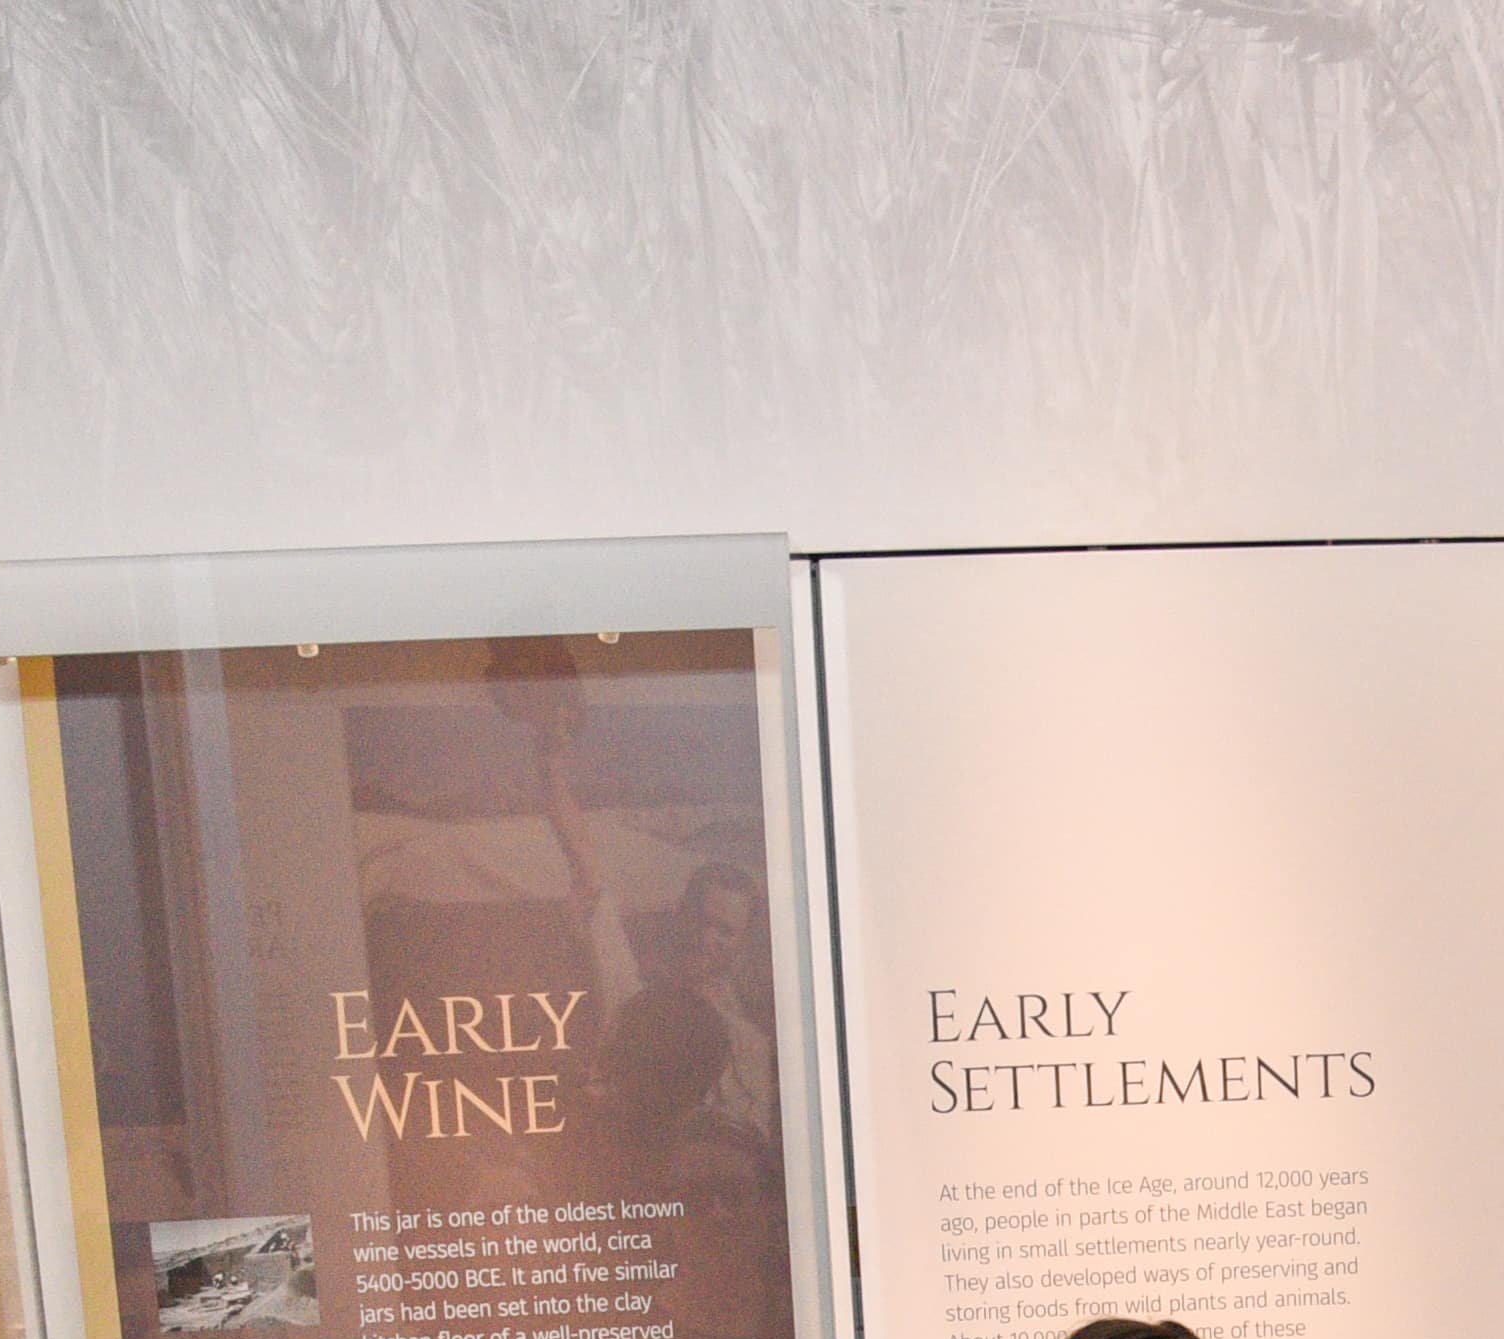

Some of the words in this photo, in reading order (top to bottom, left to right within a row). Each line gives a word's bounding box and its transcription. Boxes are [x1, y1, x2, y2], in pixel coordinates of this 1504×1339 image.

[330, 990, 587, 1061] EARLY
[927, 989, 1132, 1043] EARLY
[930, 1050, 1376, 1114] SETTLEMENTS
[332, 1072, 566, 1141] WINE
[939, 1184, 958, 1201] At
[965, 1182, 995, 1200] the
[1002, 1179, 1036, 1198] end
[1045, 1178, 1062, 1196] of
[1069, 1177, 1099, 1196] the
[1107, 1177, 1132, 1194] Ice
[1139, 1176, 1176, 1197] Age,
[1183, 1171, 1248, 1191] around
[1256, 1169, 1312, 1189] 12,000
[1319, 1170, 1368, 1189] years
[350, 1211, 390, 1231] This
[396, 1210, 420, 1233] jar
[427, 1208, 442, 1227] is
[448, 1211, 484, 1226] one
[491, 1204, 510, 1225] of
[516, 1204, 548, 1223] the
[555, 1202, 614, 1221] oldest
[621, 1199, 683, 1218] known
[941, 1242, 989, 1264] living
[996, 1241, 1011, 1259] in
[1019, 1238, 1067, 1258] small
[1075, 1236, 1186, 1255] settlements
[1194, 1232, 1249, 1252] nearly
[1256, 1227, 1359, 1252] year-round.
[356, 1270, 458, 1292] 5400-5000
[465, 1268, 504, 1287] BCE.
[512, 1267, 525, 1284] It
[531, 1264, 566, 1284] and
[573, 1262, 608, 1282] five
[615, 1259, 677, 1280] similar
[944, 1273, 988, 1294] They
[995, 1271, 1033, 1289] also
[1041, 1266, 1136, 1288] developed
[1143, 1267, 1189, 1285] ways
[1196, 1262, 1213, 1280] of
[1221, 1258, 1318, 1283] preserving
[1324, 1256, 1357, 1275] and
[360, 1304, 394, 1326] jars
[400, 1301, 435, 1320] had
[443, 1300, 490, 1319] been
[498, 1298, 528, 1316] set
[534, 1295, 570, 1314] into
[576, 1293, 608, 1312] the
[614, 1292, 651, 1313] clay
[945, 1302, 1010, 1323] storing
[1017, 1299, 1068, 1318] foods
[1075, 1297, 1117, 1316] from
[1125, 1295, 1161, 1313] wild
[1169, 1293, 1226, 1312] plants
[1233, 1290, 1267, 1309] and
[1275, 1288, 1349, 1307] animals.
[1230, 1320, 1248, 1338] of
[1255, 1320, 1305, 1337] these
